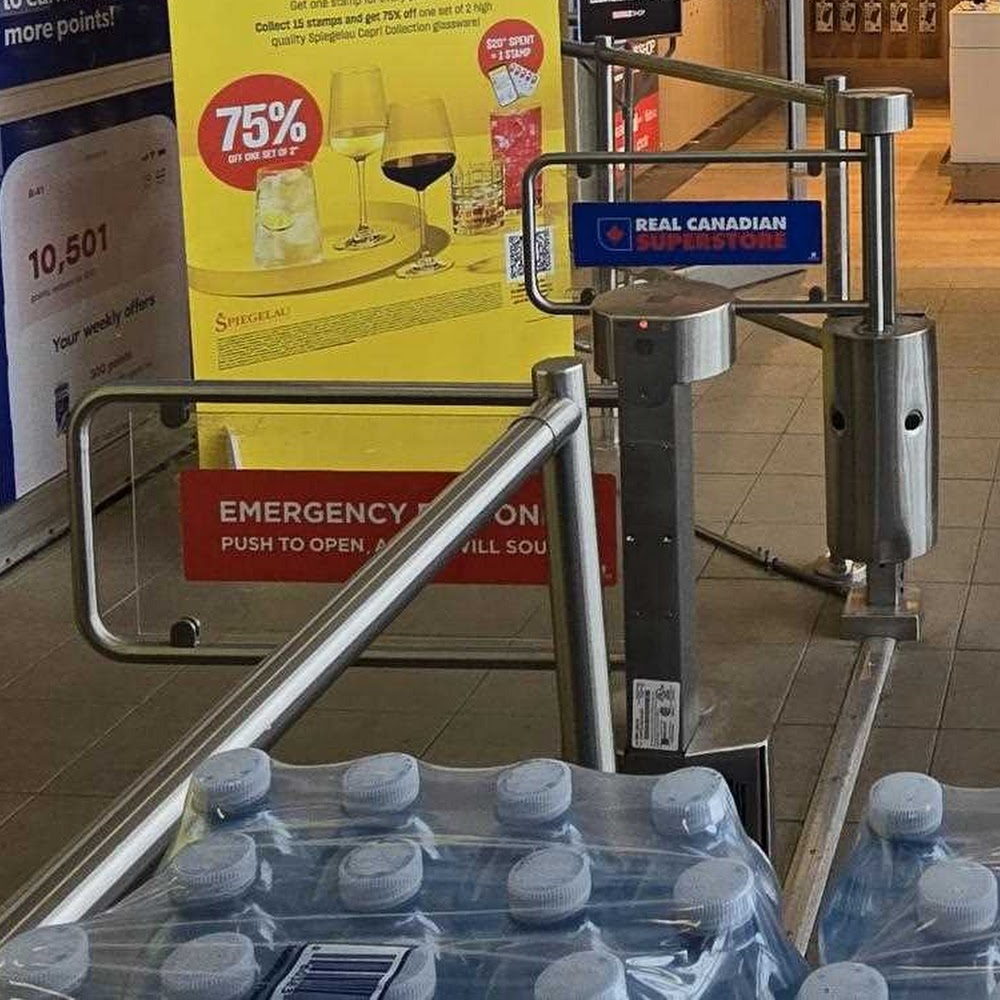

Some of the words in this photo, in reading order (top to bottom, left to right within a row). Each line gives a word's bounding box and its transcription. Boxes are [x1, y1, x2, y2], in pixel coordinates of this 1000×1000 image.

[255, 20, 291, 33] Collect
[293, 18, 304, 29] 15
[307, 15, 342, 28] stamps
[345, 13, 363, 24] and
[365, 12, 380, 25] get
[383, 10, 401, 21] 75%
[403, 8, 417, 19] off
[419, 8, 436, 18] one
[438, 6, 452, 16] set
[455, 4, 465, 14] of
[466, 3, 472, 13] 2
[474, 2, 492, 14] high
[290, 0, 307, 11] Get
[310, 0, 329, 9] one
[5, 13, 53, 46] more
[57, 5, 116, 38] points!
[271, 33, 305, 47] quality
[308, 29, 356, 43] Spiegelau
[358, 26, 382, 38] Capri
[385, 22, 431, 36] Collection
[505, 48, 531, 59] STAMP
[508, 35, 535, 47] SPENT
[216, 99, 307, 152] 75%
[635, 217, 681, 231] REAL
[686, 216, 786, 231] CANADIAN
[28, 223, 108, 279] 10,501
[636, 232, 787, 250] SUPERSTORE
[53, 330, 80, 353] Your
[83, 309, 121, 338] weekly
[124, 295, 156, 317] offers
[220, 501, 407, 524] EMERGENCY
[495, 503, 546, 526] ON
[221, 537, 272, 551] PUSH
[278, 537, 304, 551] TO
[506, 540, 548, 554] SOU
